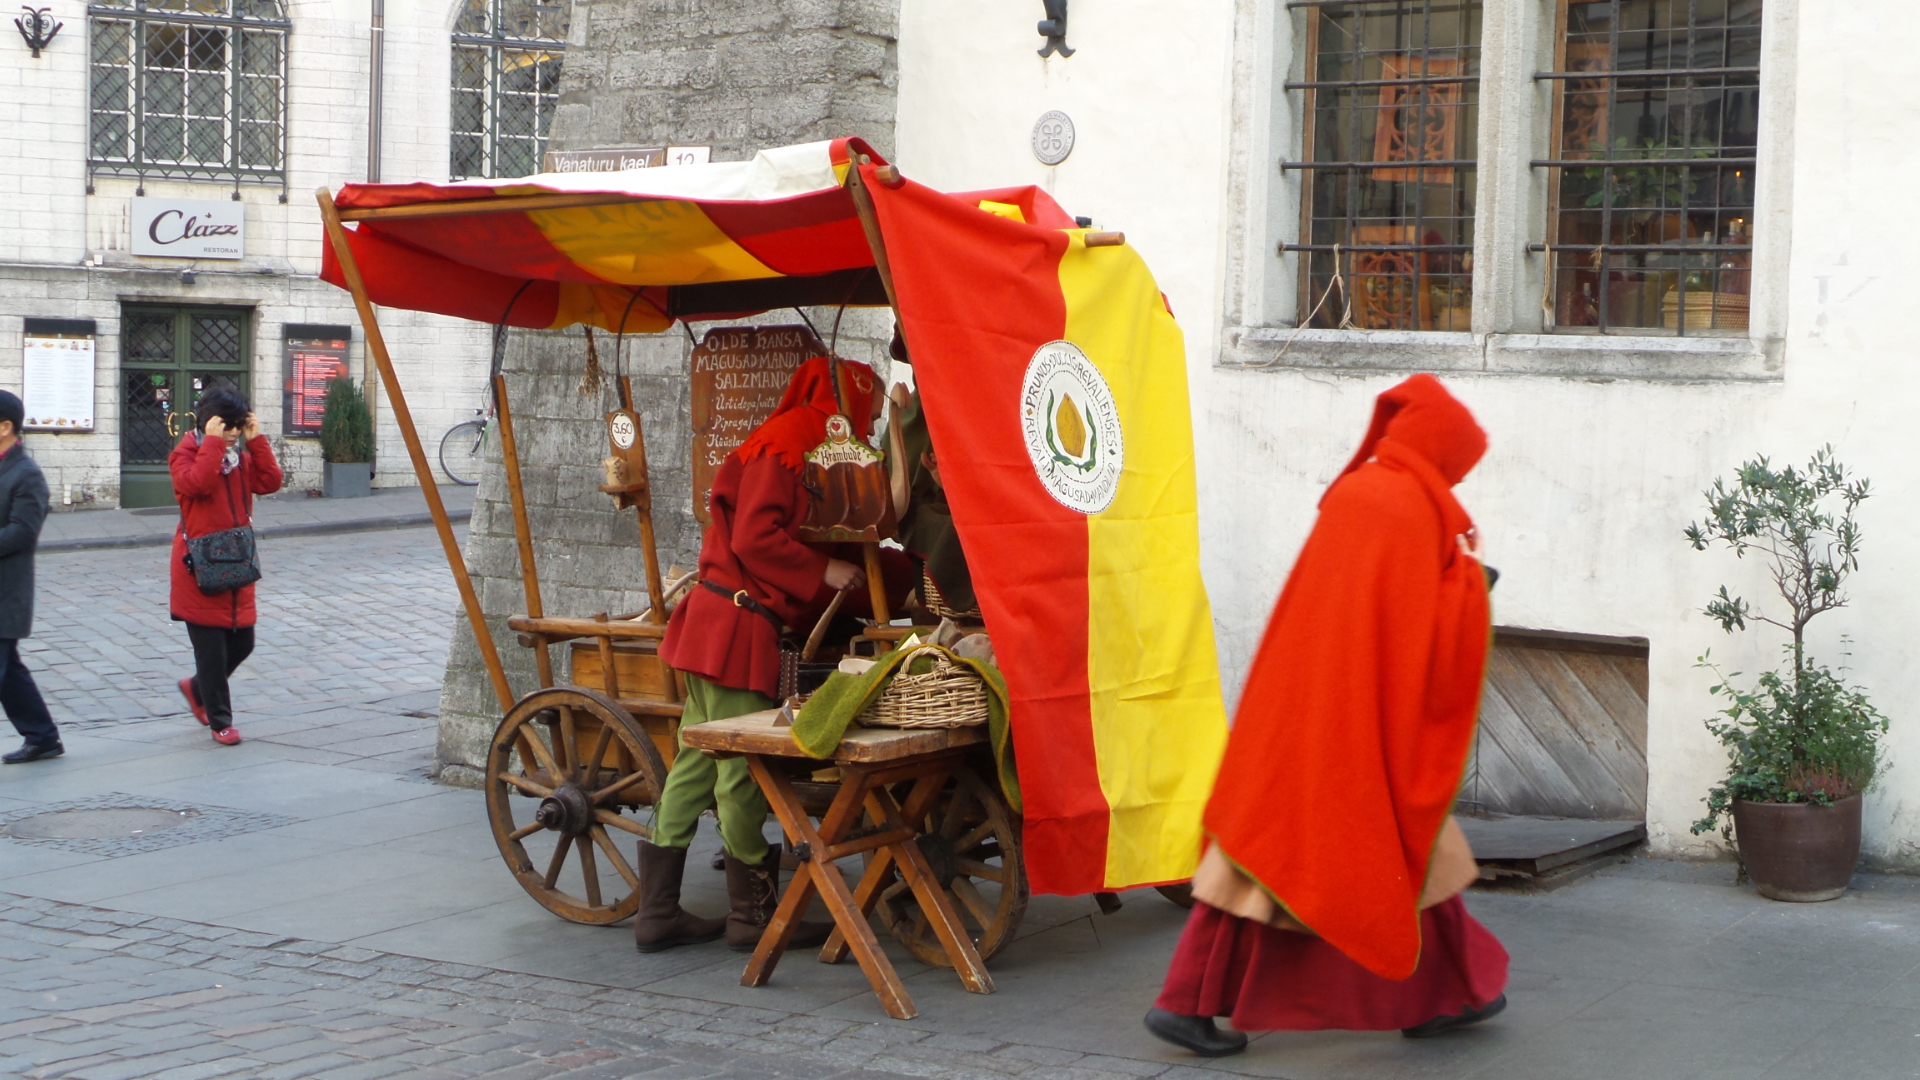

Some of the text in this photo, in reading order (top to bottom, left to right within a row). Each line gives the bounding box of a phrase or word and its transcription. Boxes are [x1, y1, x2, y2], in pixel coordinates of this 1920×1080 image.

[555, 154, 650, 173] Vanaturu kael
[148, 209, 239, 245] Clazz
[705, 332, 749, 352] OLDE
[613, 422, 633, 435] 3.60
